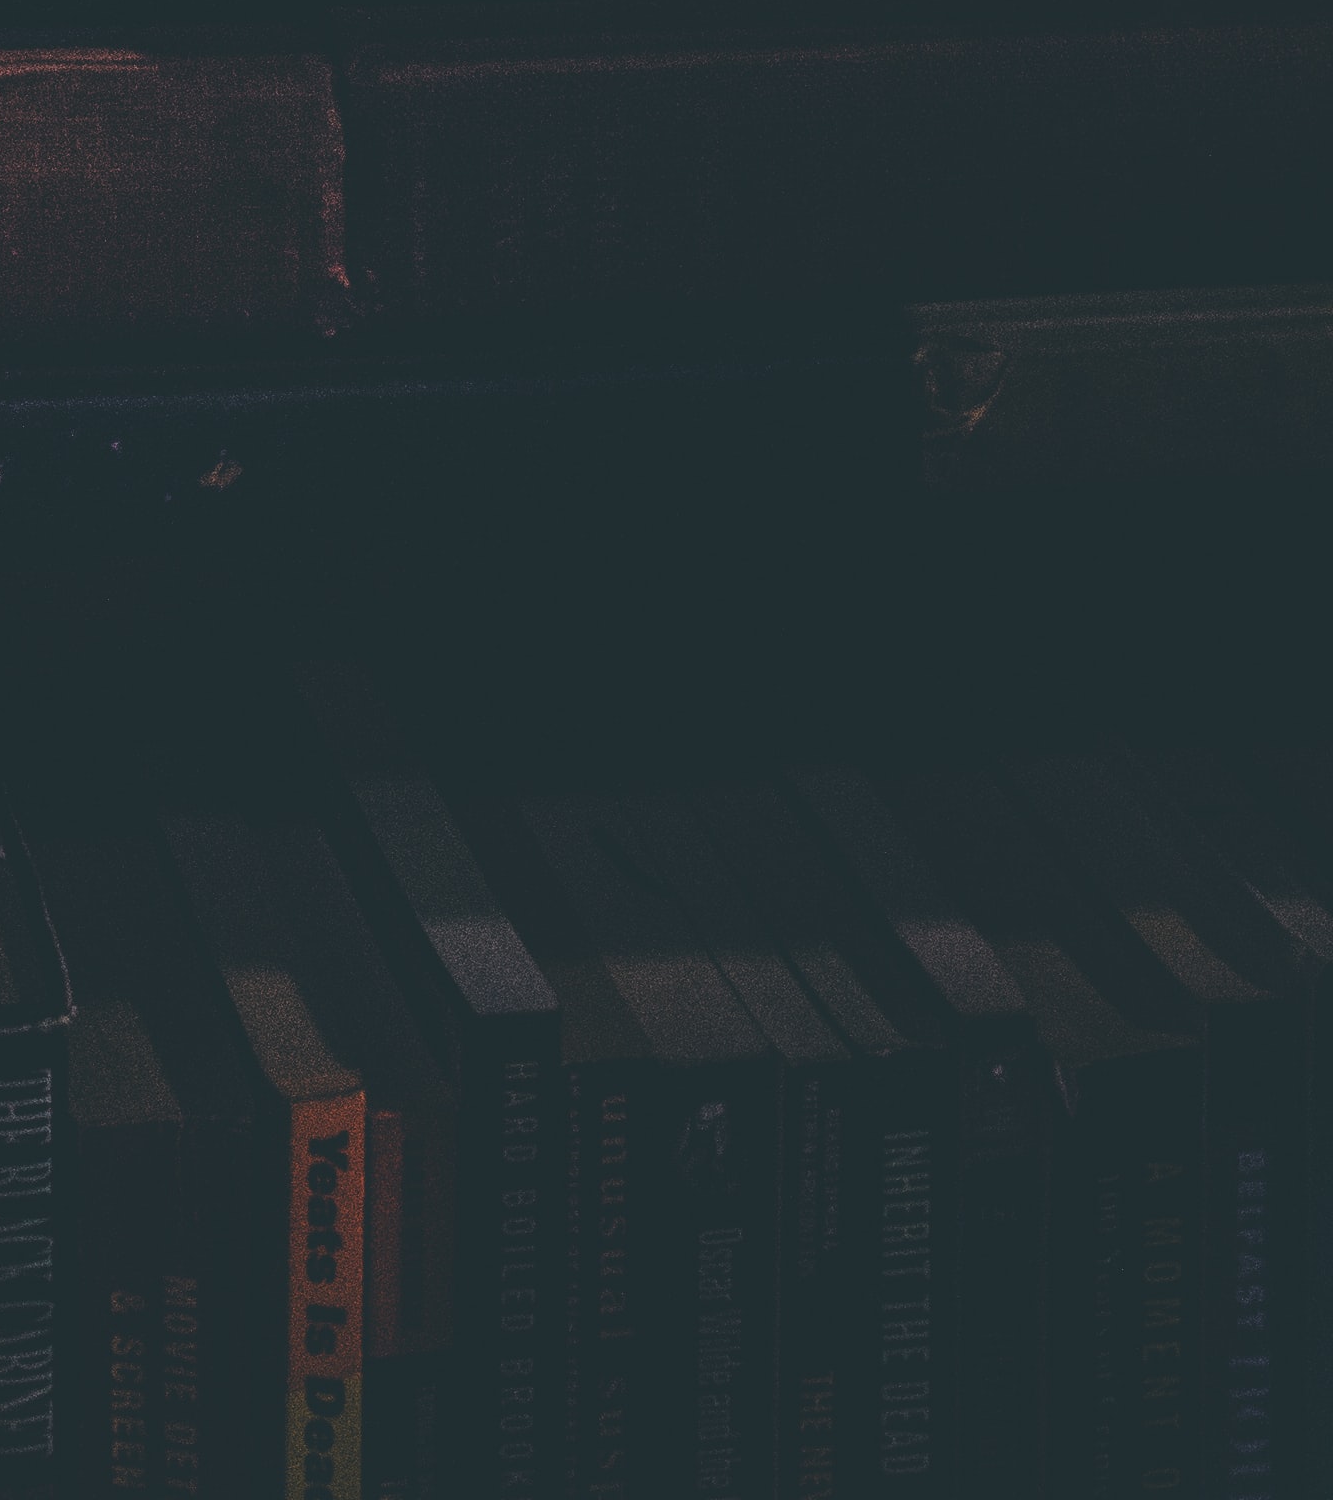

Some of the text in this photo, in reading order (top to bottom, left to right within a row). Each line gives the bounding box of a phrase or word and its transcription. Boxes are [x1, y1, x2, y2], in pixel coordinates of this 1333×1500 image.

[499, 1060, 540, 1165] HARD
[305, 1131, 351, 1287] Yeats
[499, 1190, 539, 1333] BOILED
[594, 1093, 638, 1342] unusual
[1235, 1148, 1269, 1331] BELFAST
[162, 1274, 200, 1407] MOVIE
[304, 1303, 348, 1356] Is
[697, 1225, 745, 1492] Oscar Wilde and the
[879, 1129, 933, 1478] INHERIT THE DEAD
[1142, 1216, 1184, 1433] MOMENT
[108, 1336, 147, 1490] SCREEN
[798, 1369, 836, 1439] THE
